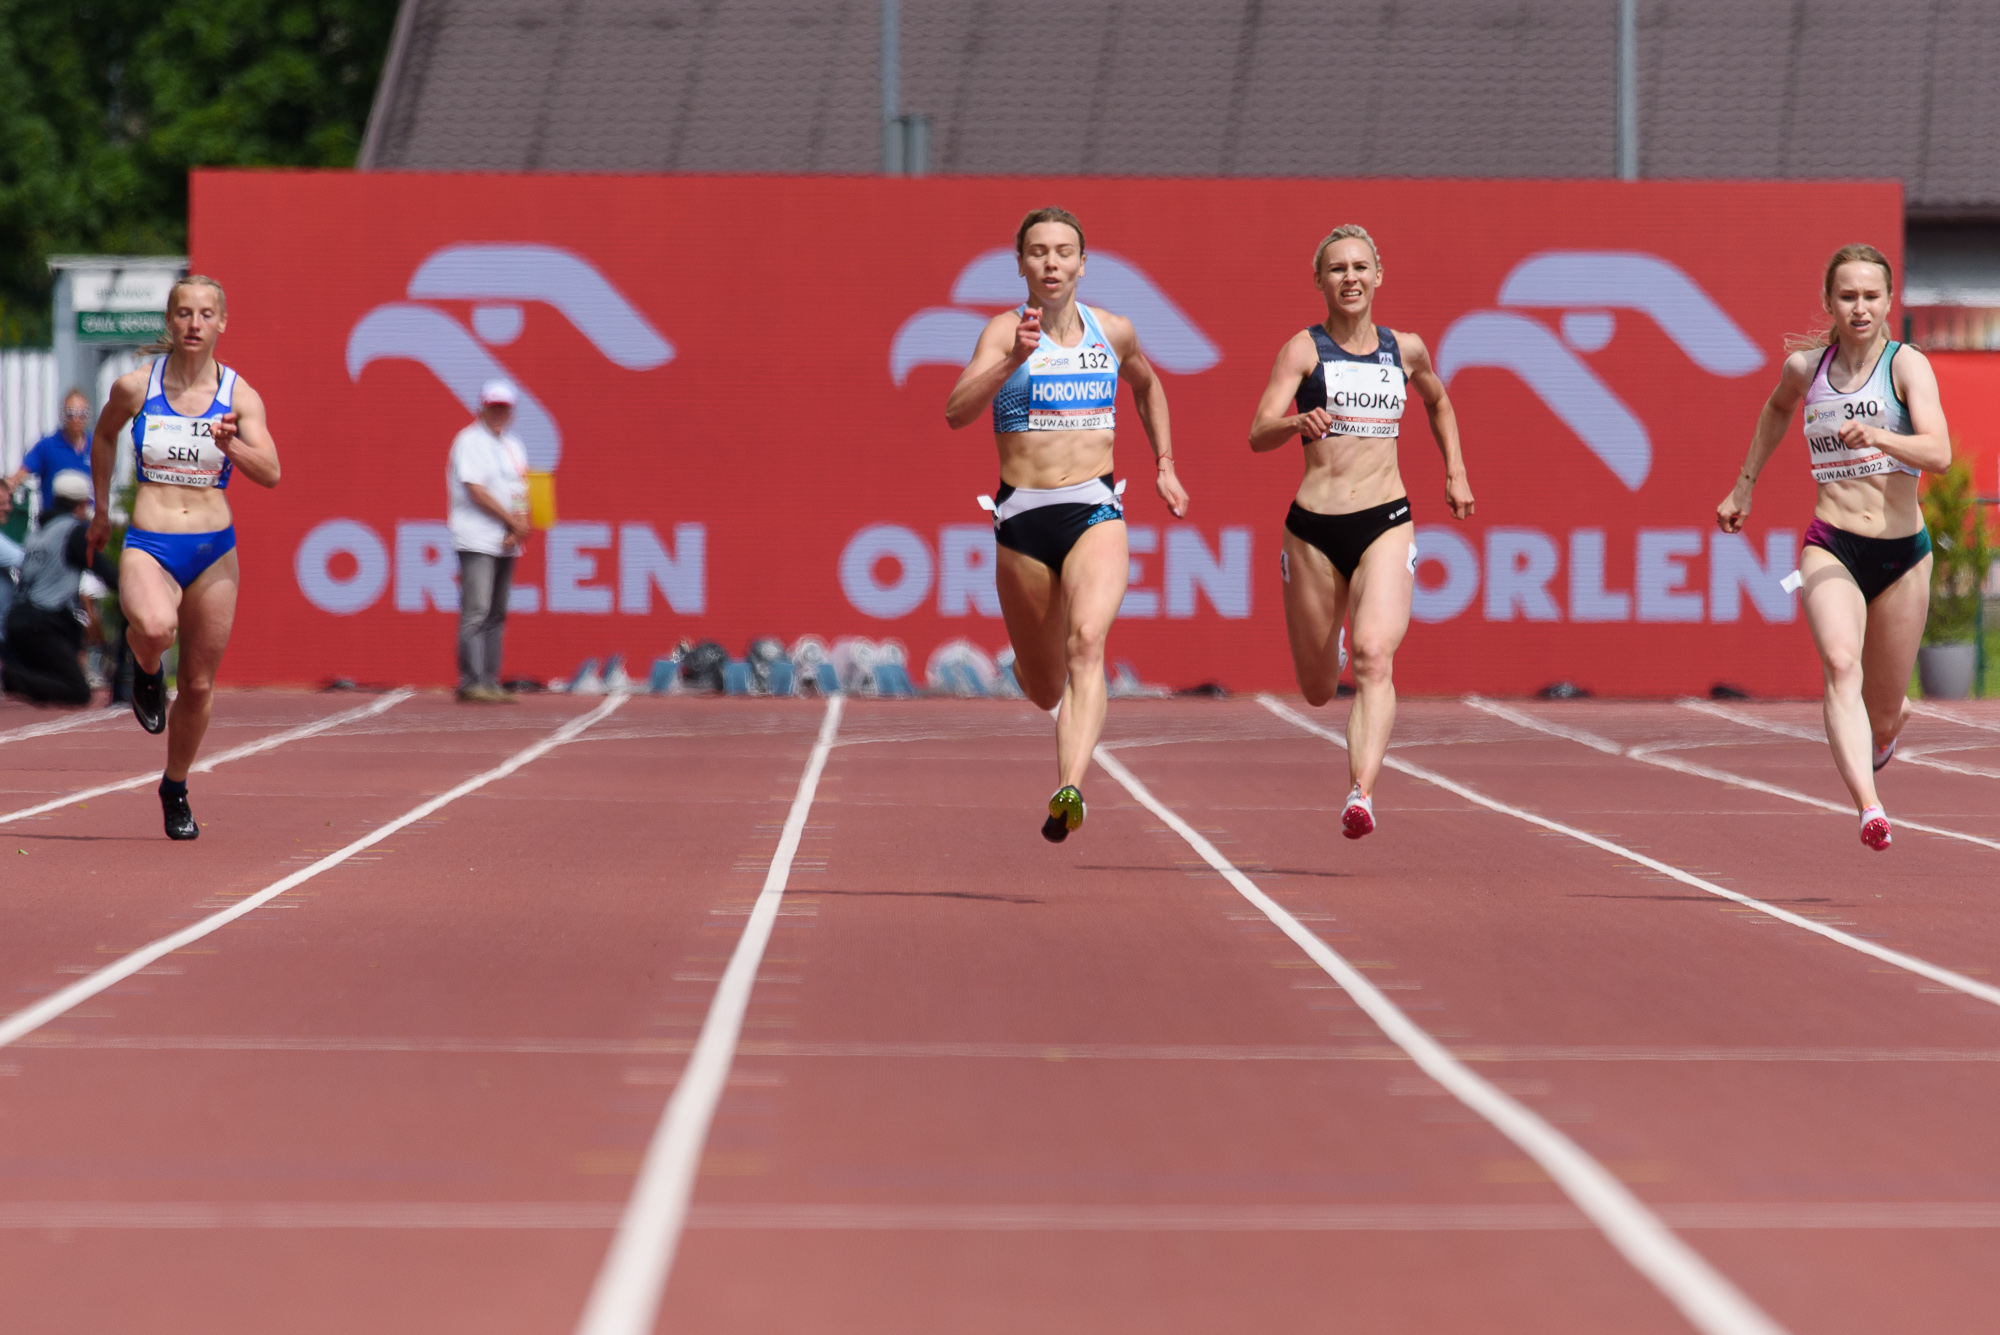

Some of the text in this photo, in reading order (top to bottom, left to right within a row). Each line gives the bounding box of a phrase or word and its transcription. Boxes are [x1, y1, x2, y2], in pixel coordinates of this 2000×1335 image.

[1078, 352, 1108, 369] 132
[1380, 368, 1390, 383] 2
[1032, 381, 1112, 402] HOROWSKA
[1334, 391, 1400, 410] CHOJKA
[1843, 400, 1878, 420] 340
[1033, 418, 1101, 428] SUWAŁKI 2022
[1372, 426, 1391, 435] 2022
[168, 445, 199, 463] SEŃ
[145, 470, 208, 485] SUWAŁKI 2022
[1816, 462, 1884, 481] SUWAŁKI 2022
[294, 518, 706, 616] OREN
[837, 523, 1252, 621] ORN
[1409, 526, 1799, 624] ORLEN
